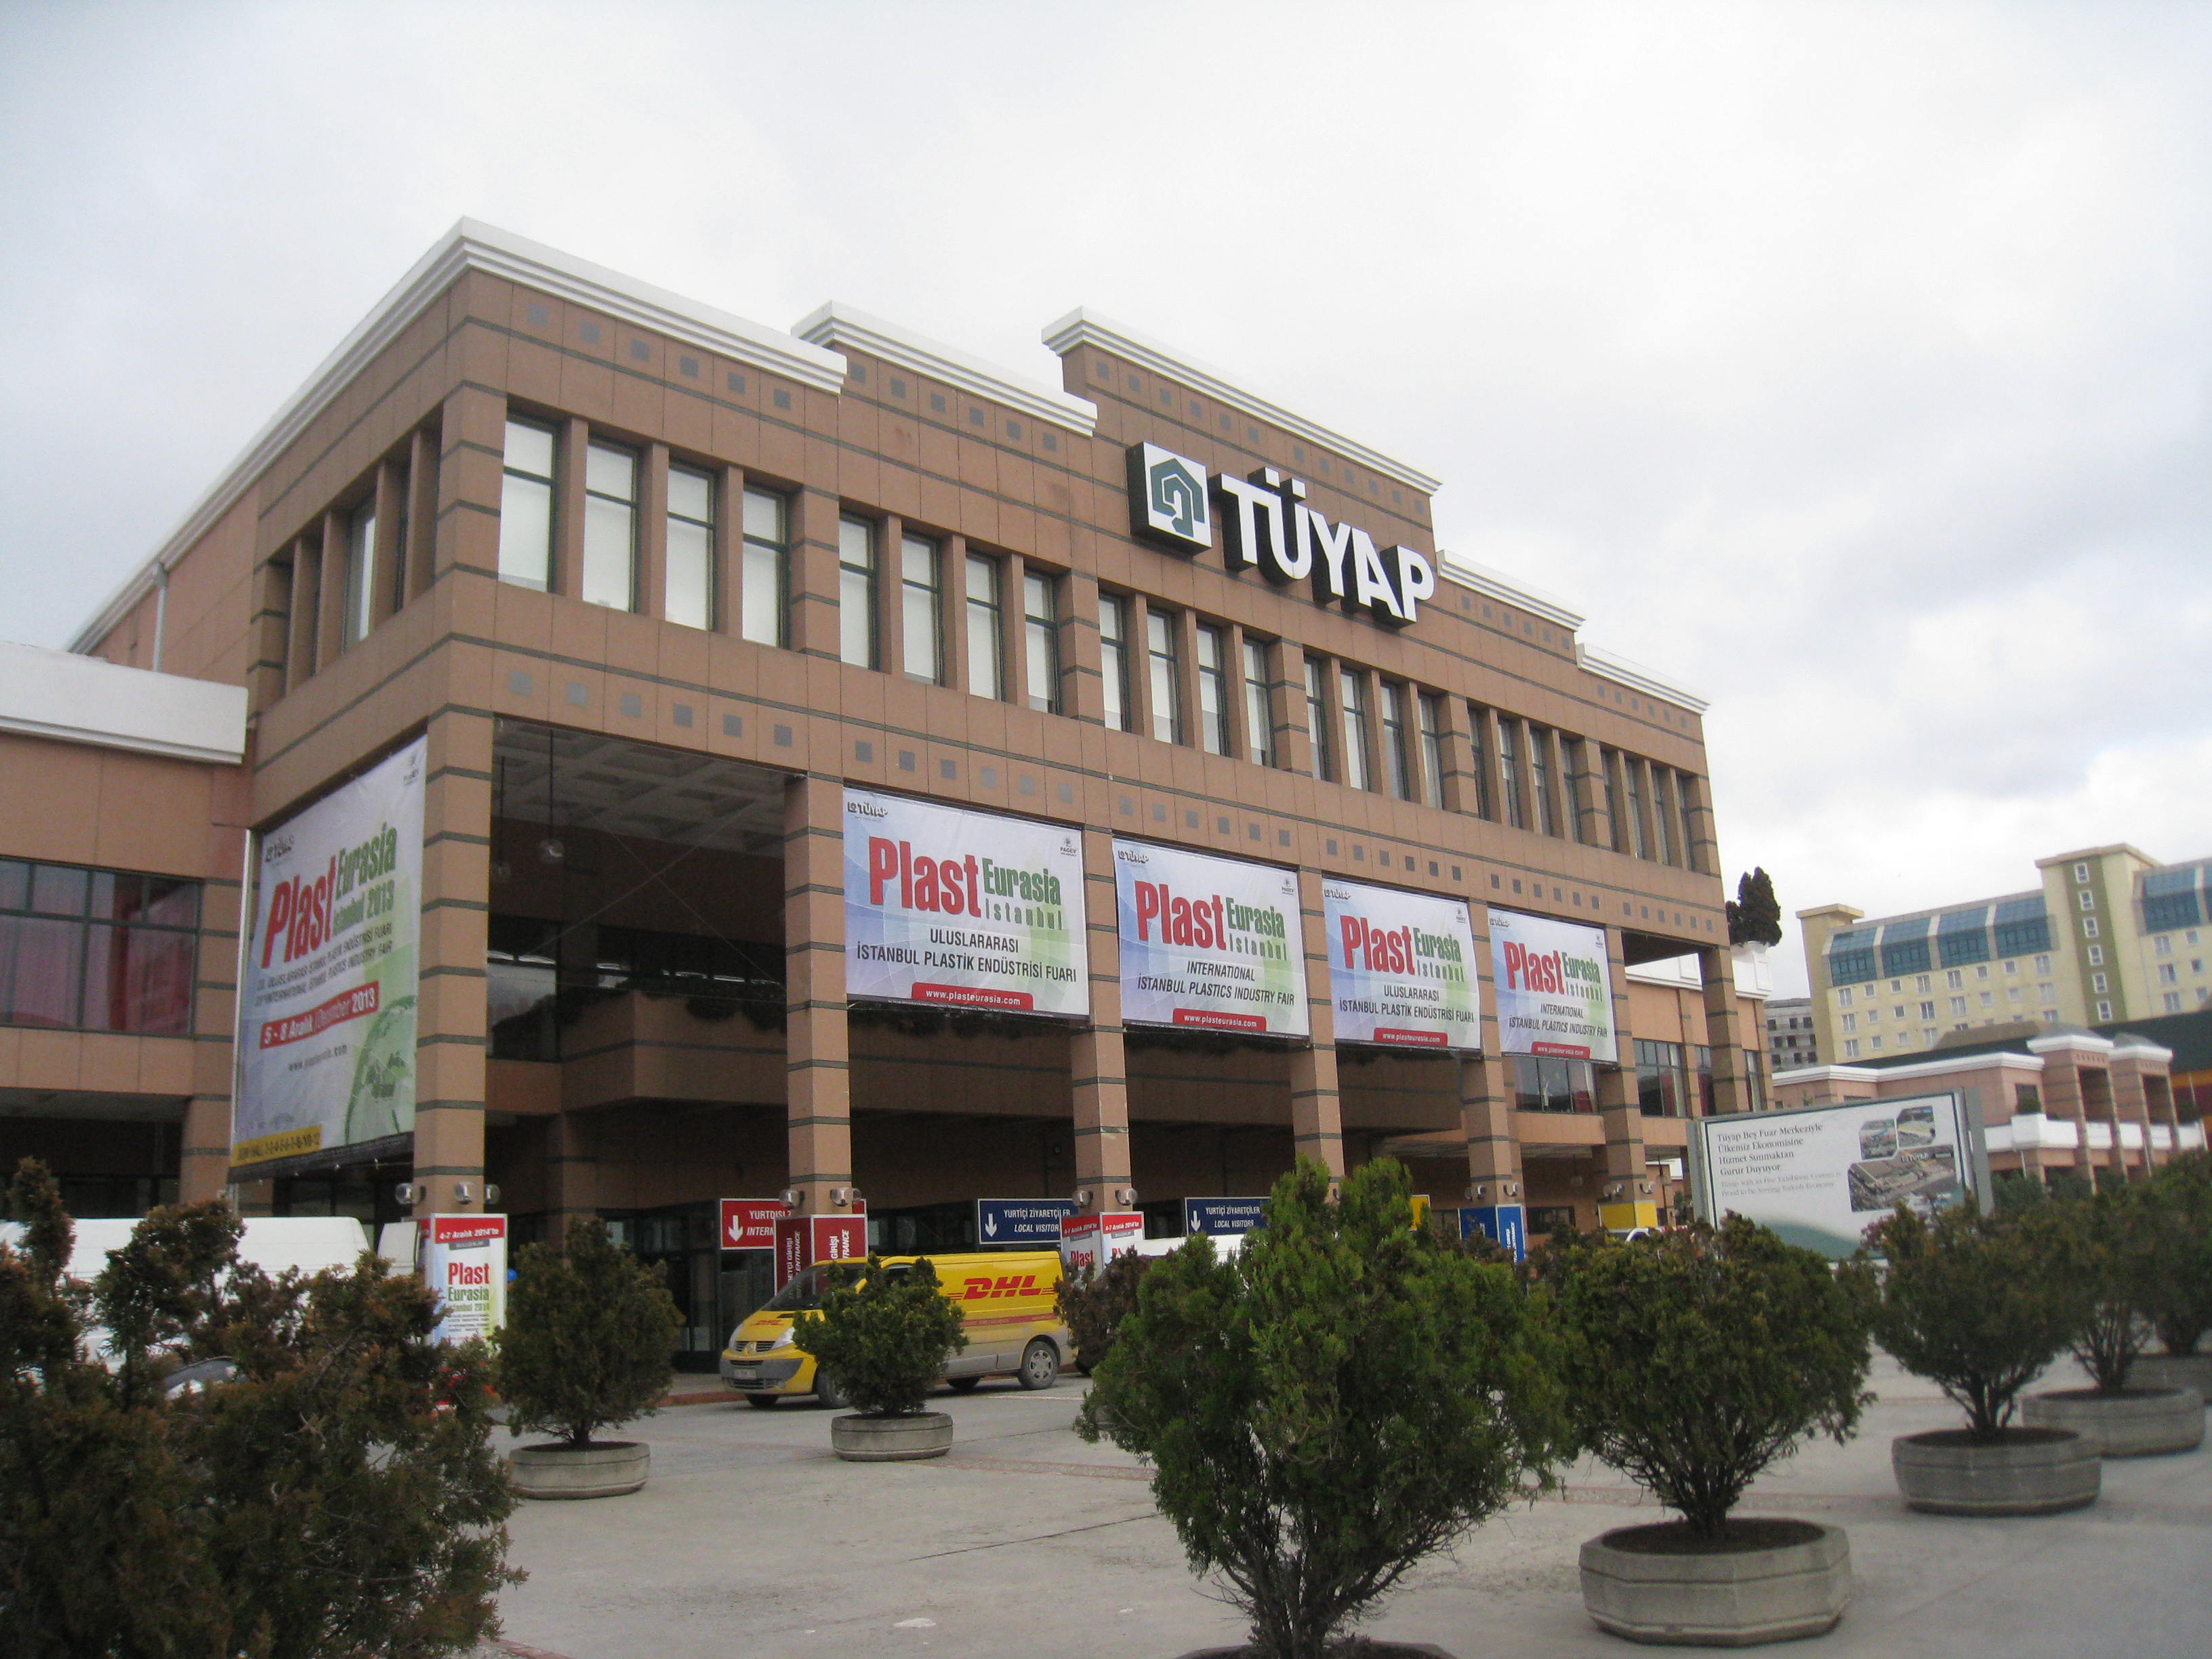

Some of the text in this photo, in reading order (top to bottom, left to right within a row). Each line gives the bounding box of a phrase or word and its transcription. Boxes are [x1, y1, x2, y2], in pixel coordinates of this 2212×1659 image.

[1221, 466, 1435, 623] TÜYAP
[869, 836, 1061, 918] Plast Eurasia
[261, 821, 397, 969] Plast Eurasia
[367, 879, 396, 919] 2013
[1134, 880, 1286, 950] Plast Eurasia
[930, 928, 1019, 954] ULUSLARARASI
[1340, 915, 1462, 975] Plast Eurasia
[857, 941, 1077, 983] İSTANBUL PLASTİK ENDÜSTRİSİ FUARI
[1187, 961, 1255, 981] INTERNATIONAL
[1502, 941, 1601, 995] Plast Eurasia
[352, 987, 375, 1012] 2013
[926, 989, 1021, 1006] www.plasteurasia.com
[1189, 982, 1231, 998] PLASTICS
[1234, 986, 1275, 1003] INDUSTRY
[1277, 992, 1294, 1006] FAIR
[1384, 985, 1439, 1002] ULUSLARARASI
[1184, 1014, 1257, 1028] www.plasteurasia.com
[1340, 997, 1474, 1023] İSTANBUL PLASTİK ENDÜSTRİSİ FUARI
[1540, 1003, 1584, 1019] INTERNATIONAL
[1542, 1021, 1568, 1033] PLASTICS
[1570, 1022, 1595, 1036] INDUSTRY
[1597, 1027, 1607, 1038] FAIR
[1780, 1123, 1823, 1136] Merkeziyle
[1720, 1164, 1781, 1176] Gurur Duyuyor
[1003, 1208, 1028, 1220] YURTİÇİ
[1206, 1206, 1225, 1216] YURTİÇİ
[1014, 1224, 1033, 1232] LOCAL
[1214, 1220, 1230, 1228] LOCAL
[829, 1235, 839, 1259] GİRİŞİ
[448, 1262, 490, 1285] Plast
[448, 1286, 489, 1302] Eurasia
[963, 1275, 1042, 1300] DHL
